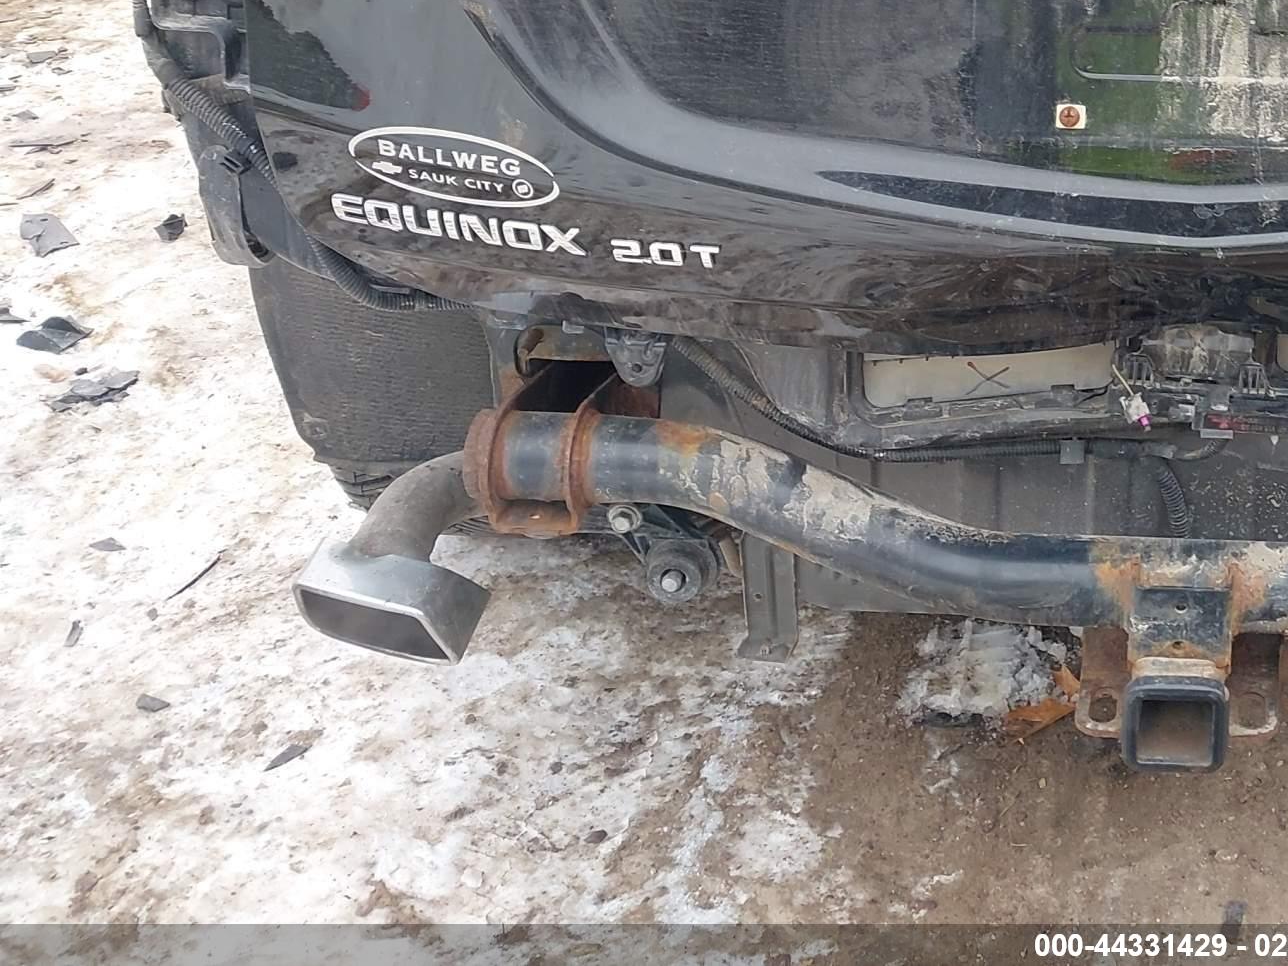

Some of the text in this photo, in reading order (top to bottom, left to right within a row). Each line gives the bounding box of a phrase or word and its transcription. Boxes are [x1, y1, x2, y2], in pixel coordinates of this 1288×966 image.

[377, 139, 521, 177] BALLWEG
[408, 168, 505, 194] SAUK CITY
[330, 193, 588, 256] EQUINOX
